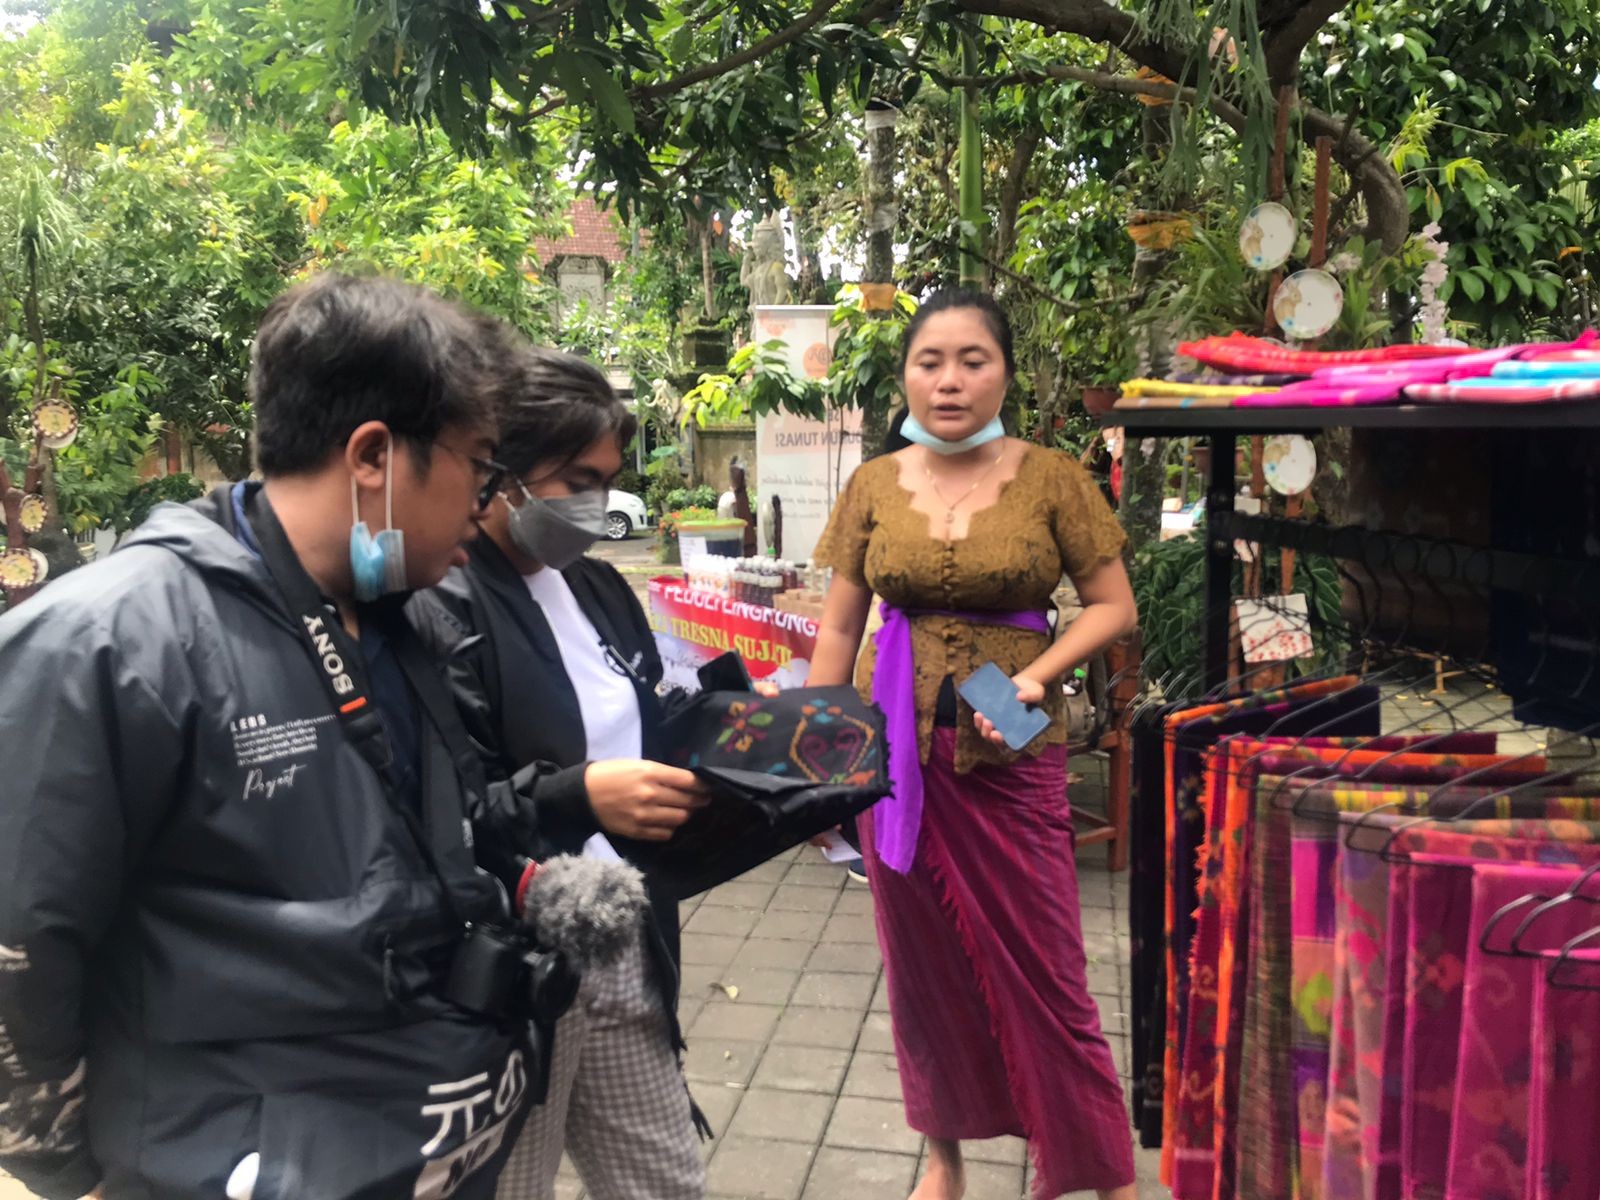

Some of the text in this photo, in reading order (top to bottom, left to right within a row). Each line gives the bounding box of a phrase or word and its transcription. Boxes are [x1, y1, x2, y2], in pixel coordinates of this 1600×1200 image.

[670, 617, 729, 651] TRESNA
[722, 600, 820, 638] LINGKUNG
[302, 614, 355, 695] SONY
